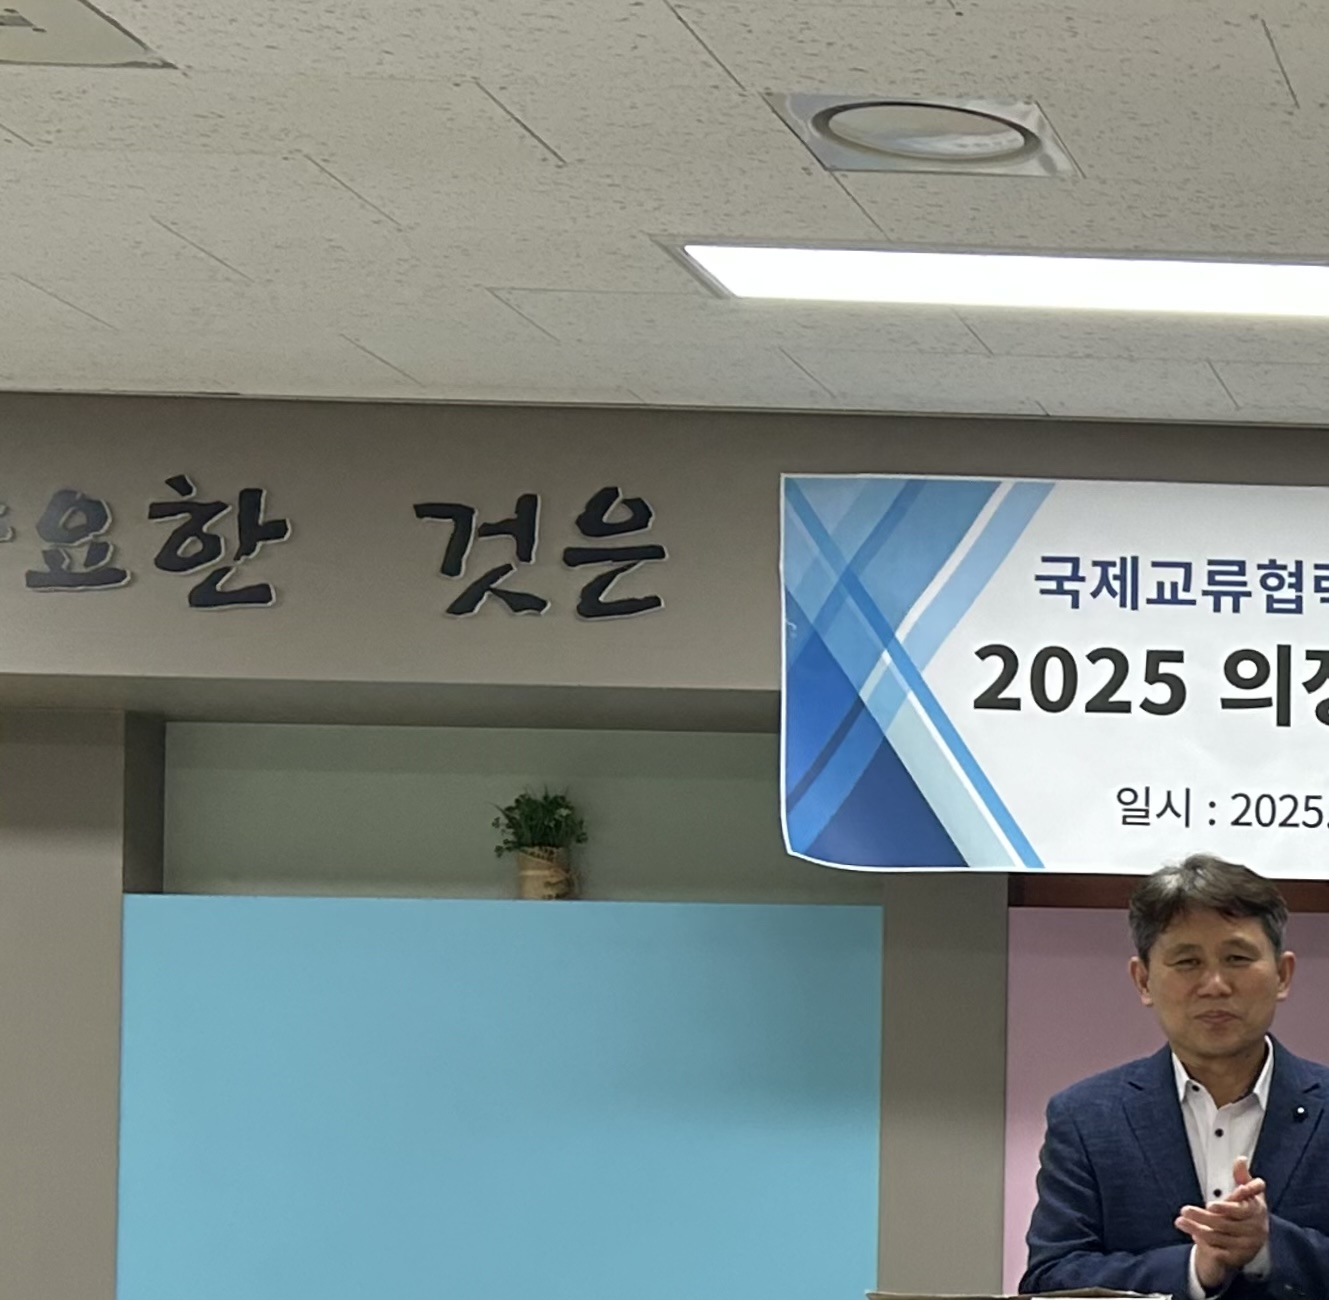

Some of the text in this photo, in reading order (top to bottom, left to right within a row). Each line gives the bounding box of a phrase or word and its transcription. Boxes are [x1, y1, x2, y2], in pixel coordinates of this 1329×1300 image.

[0, 474, 666, 619] 요한 것은
[973, 643, 1187, 716] 2025
[1116, 786, 1191, 829] 일시
[1208, 800, 1217, 826] :
